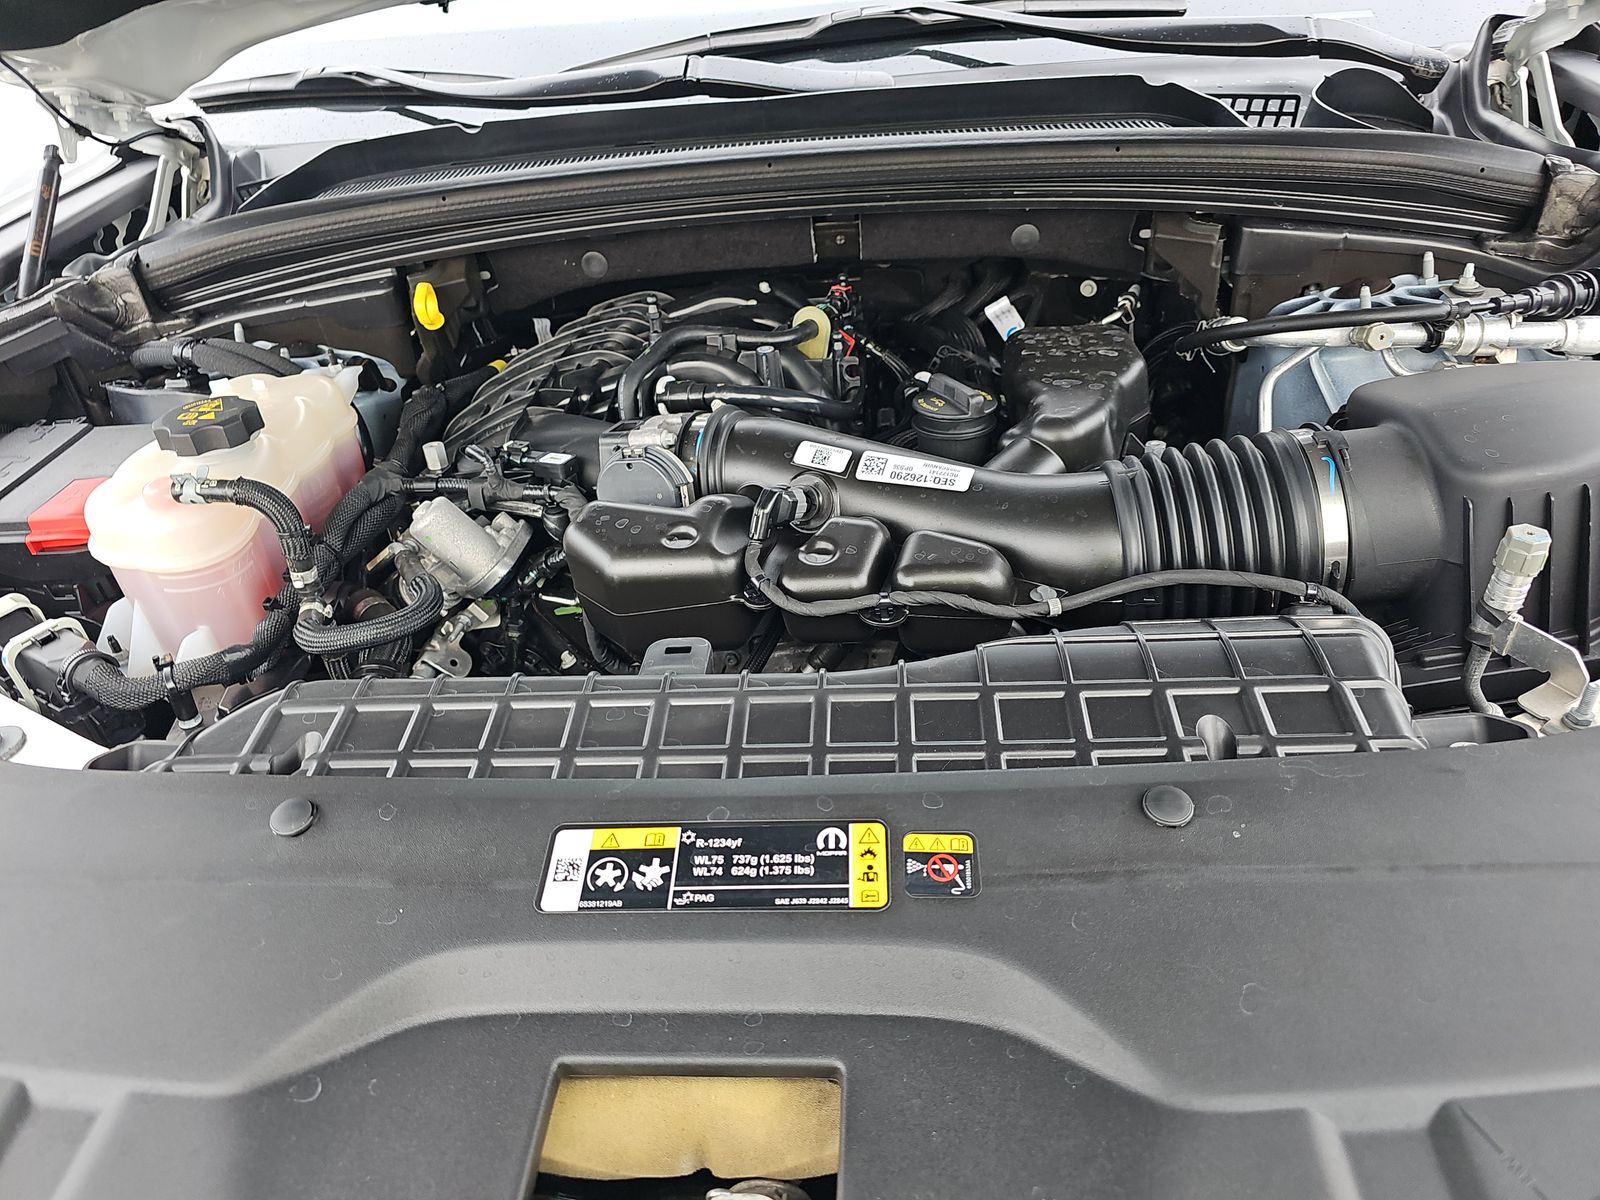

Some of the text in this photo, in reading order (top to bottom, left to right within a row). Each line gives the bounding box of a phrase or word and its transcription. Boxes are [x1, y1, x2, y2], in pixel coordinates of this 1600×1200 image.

[889, 471, 956, 486] SEQ:126290
[695, 838, 743, 849] R-1234yf
[694, 854, 815, 866] WL75 737g (1.625 lbs)
[692, 865, 815, 877] WL74 624g (1.375 lbs)
[694, 893, 715, 903] PAG
